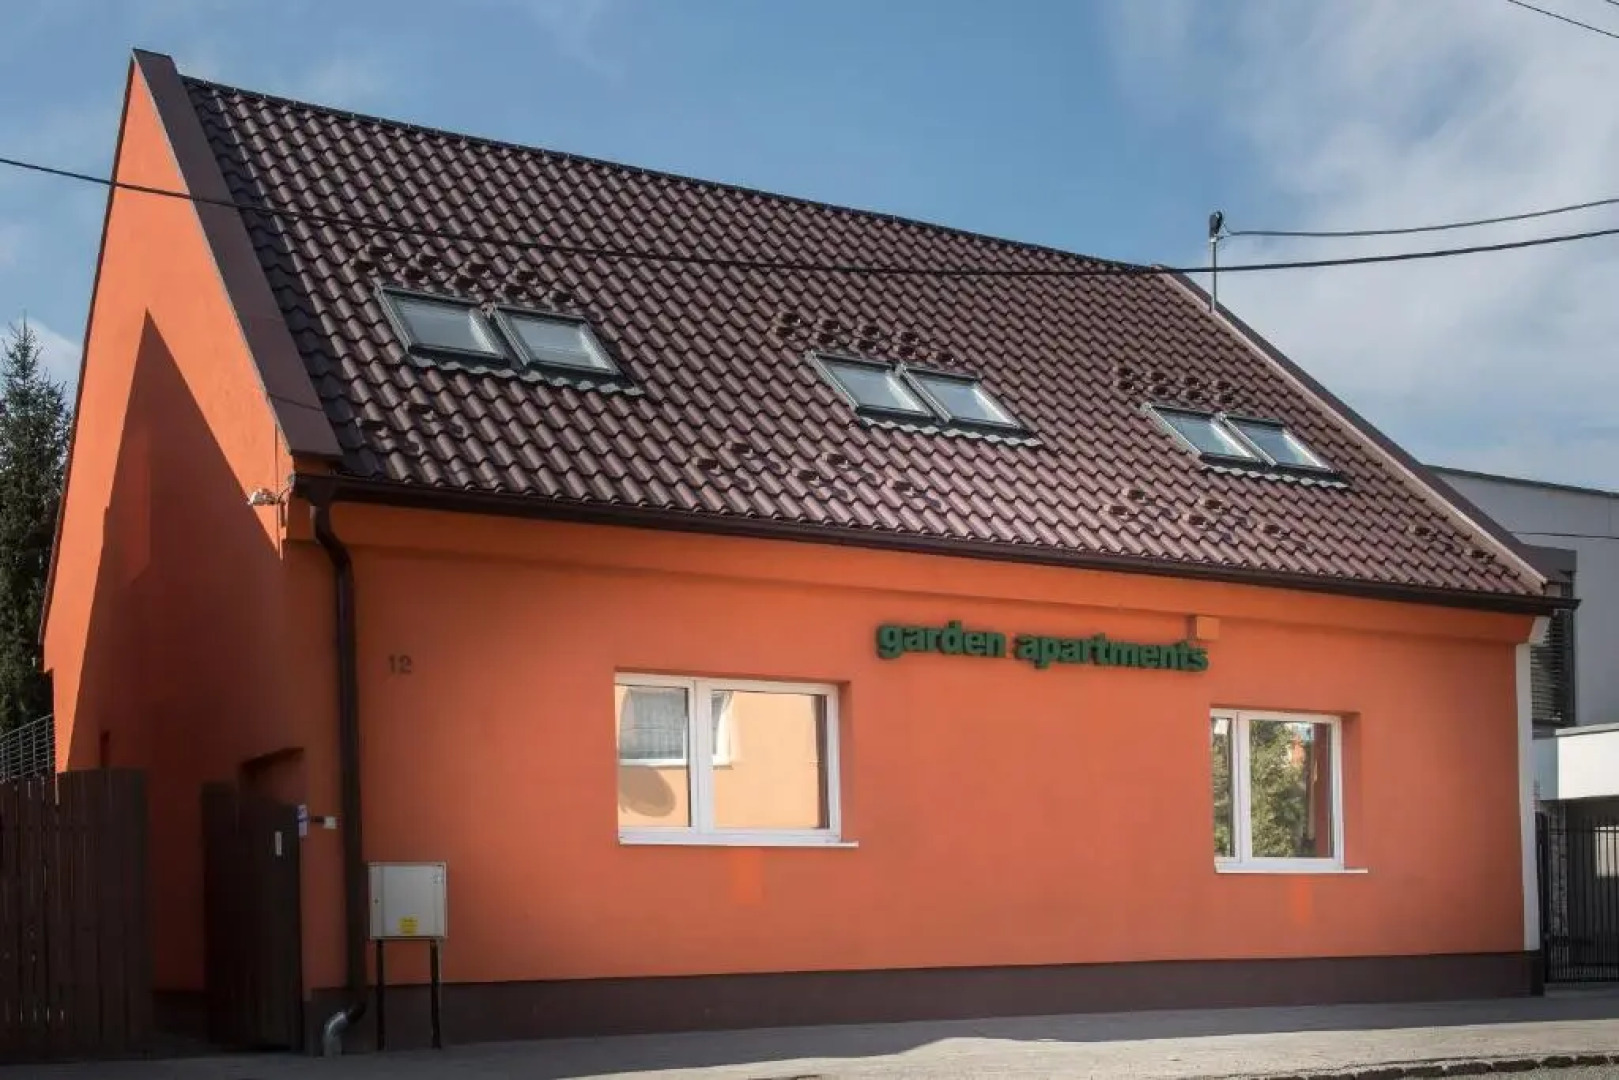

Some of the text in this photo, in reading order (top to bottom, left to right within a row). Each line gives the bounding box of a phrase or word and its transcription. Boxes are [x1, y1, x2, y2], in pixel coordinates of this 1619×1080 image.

[877, 620, 1208, 671] garden apartments
[388, 654, 412, 674] 12
